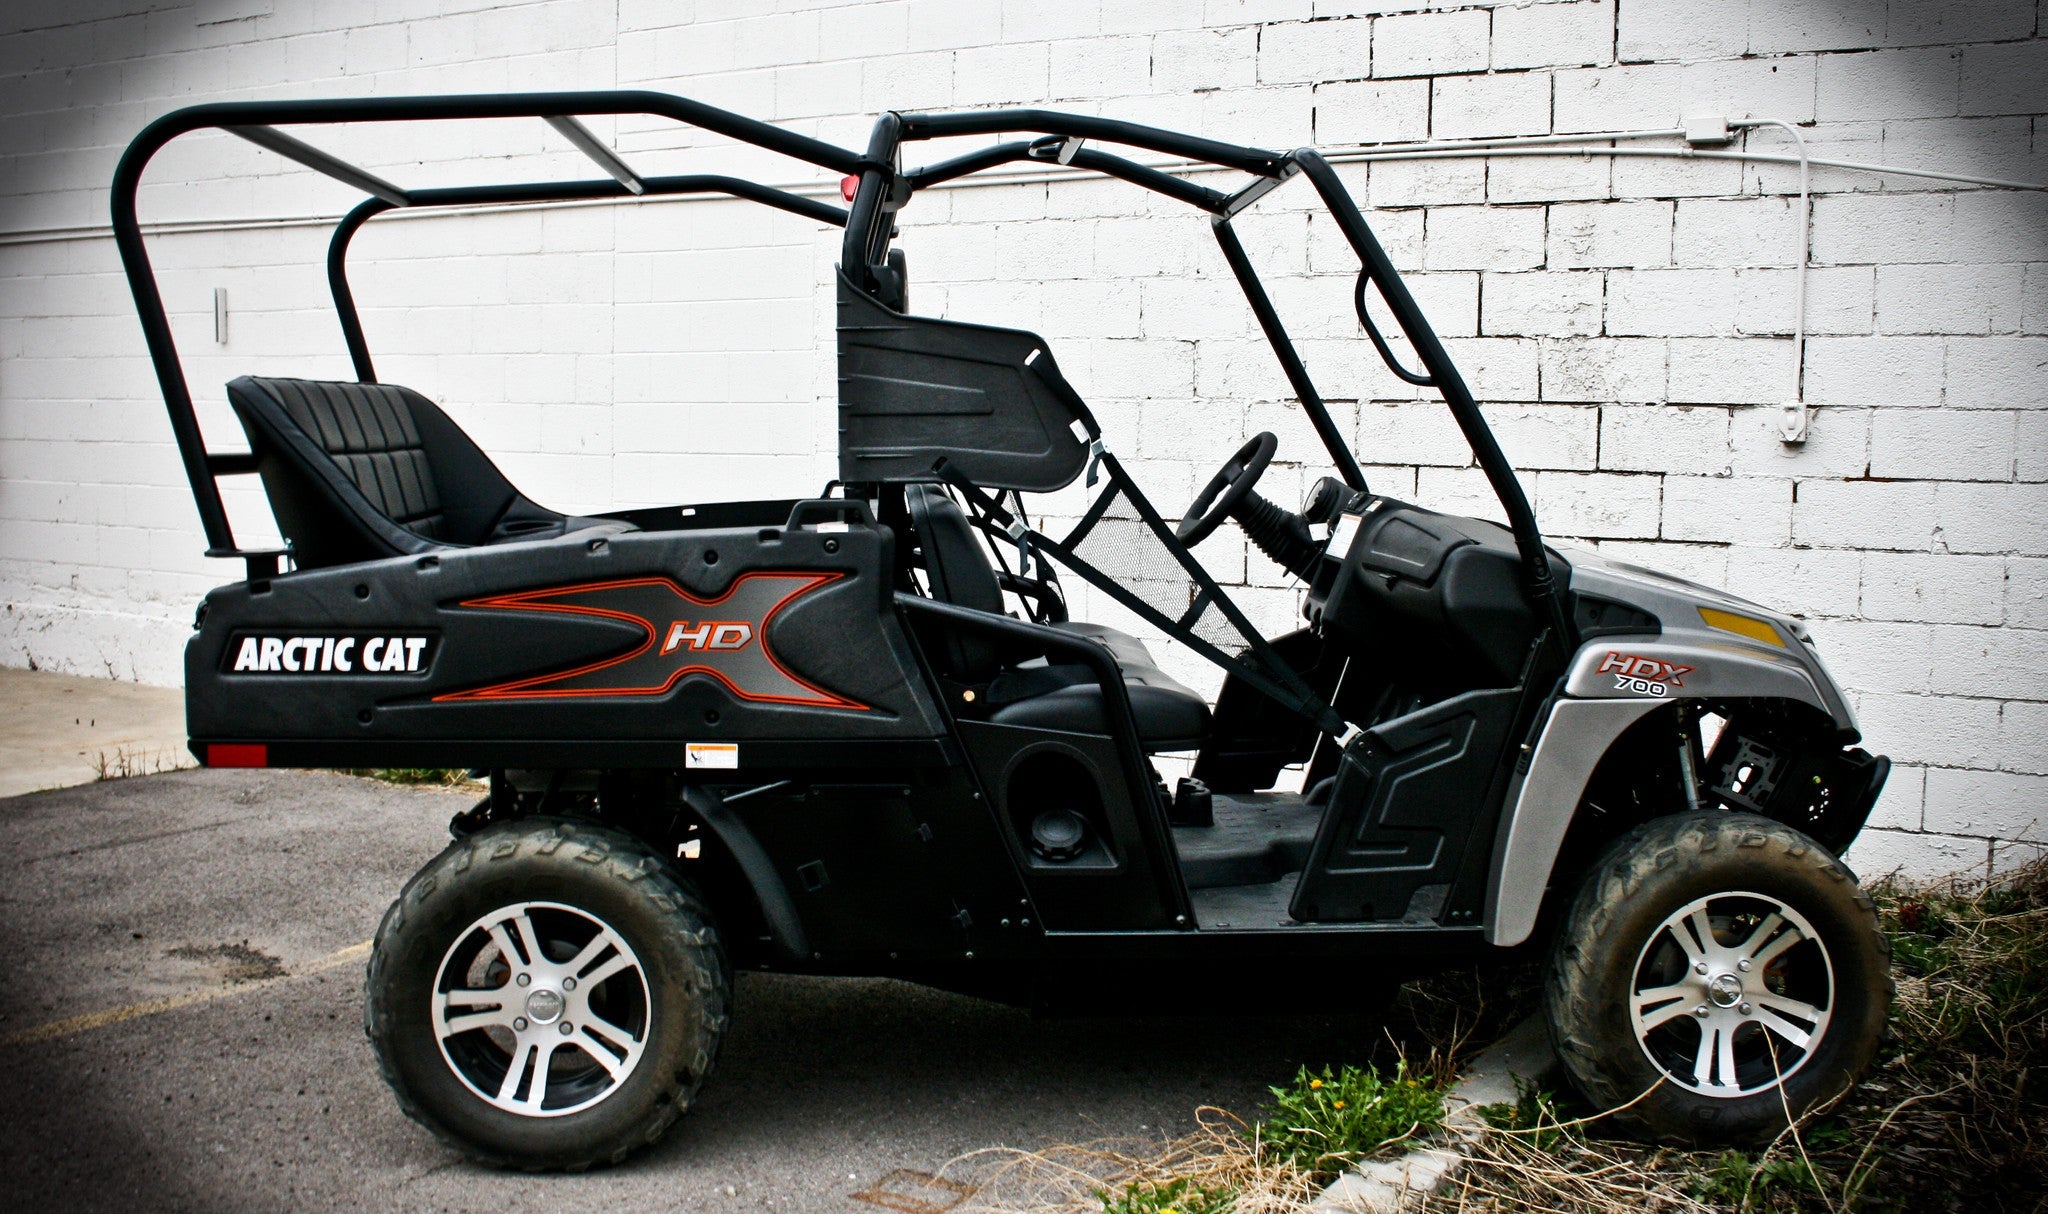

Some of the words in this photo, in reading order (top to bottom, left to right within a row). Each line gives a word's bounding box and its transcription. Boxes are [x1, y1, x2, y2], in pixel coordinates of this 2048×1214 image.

[233, 637, 355, 672] ARCTIC
[362, 637, 427, 672] CAT
[660, 621, 754, 655] HD
[1596, 651, 1696, 688] HDX
[1613, 674, 1667, 697] 700
